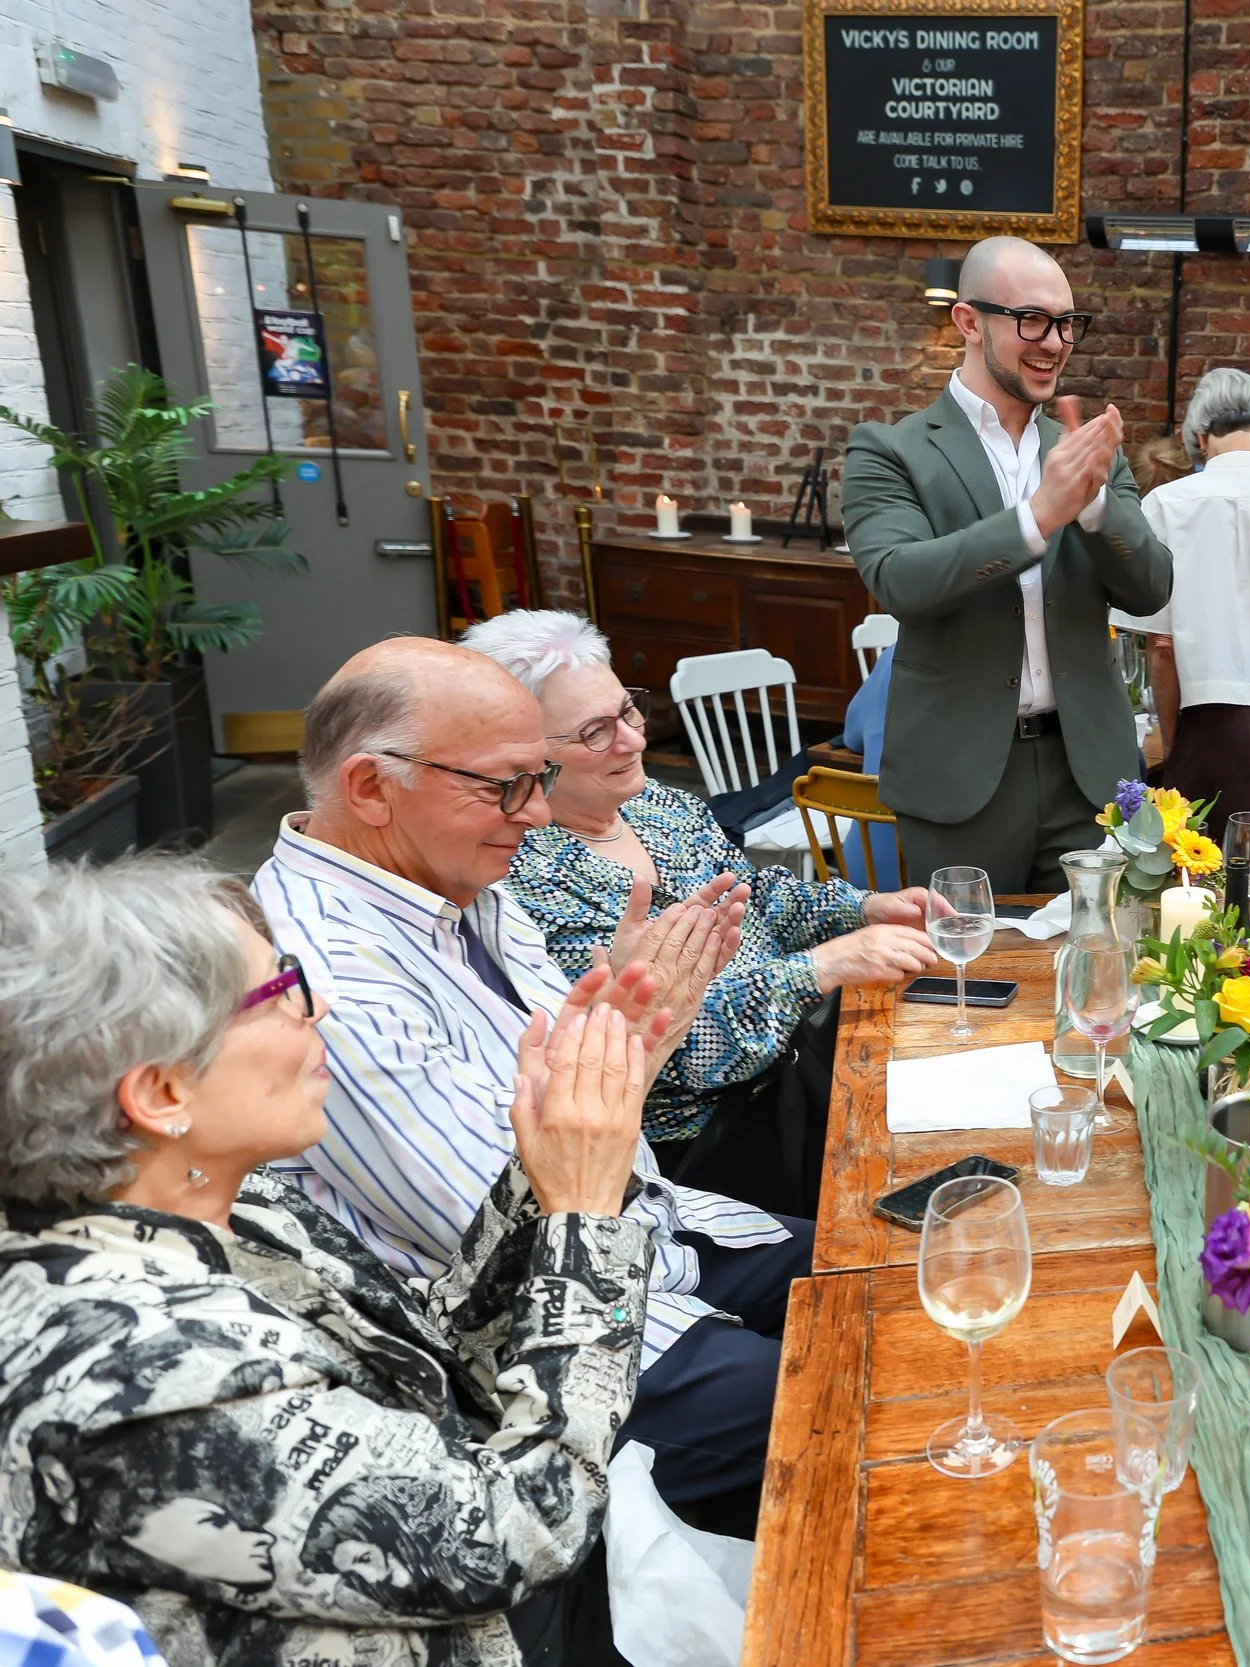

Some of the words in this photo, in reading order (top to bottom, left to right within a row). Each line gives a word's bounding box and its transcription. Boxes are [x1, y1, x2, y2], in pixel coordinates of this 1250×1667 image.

[916, 29, 980, 50] DINING
[986, 31, 1039, 50] ROOM
[935, 58, 956, 73] OUR
[892, 77, 993, 97] VICTORIAN
[885, 101, 1000, 121] COURTYARD
[857, 130, 876, 145] ARE
[878, 131, 932, 147] AVAILABLE
[934, 132, 954, 146] FOR
[955, 132, 998, 148] PRIVATE
[1000, 134, 1024, 149] HIRE
[893, 153, 920, 168] COME
[921, 154, 948, 169] TALK
[950, 155, 964, 170] TO
[535, 1279, 567, 1337] mad
[288, 1416, 333, 1471] and
[303, 1431, 360, 1491] made
